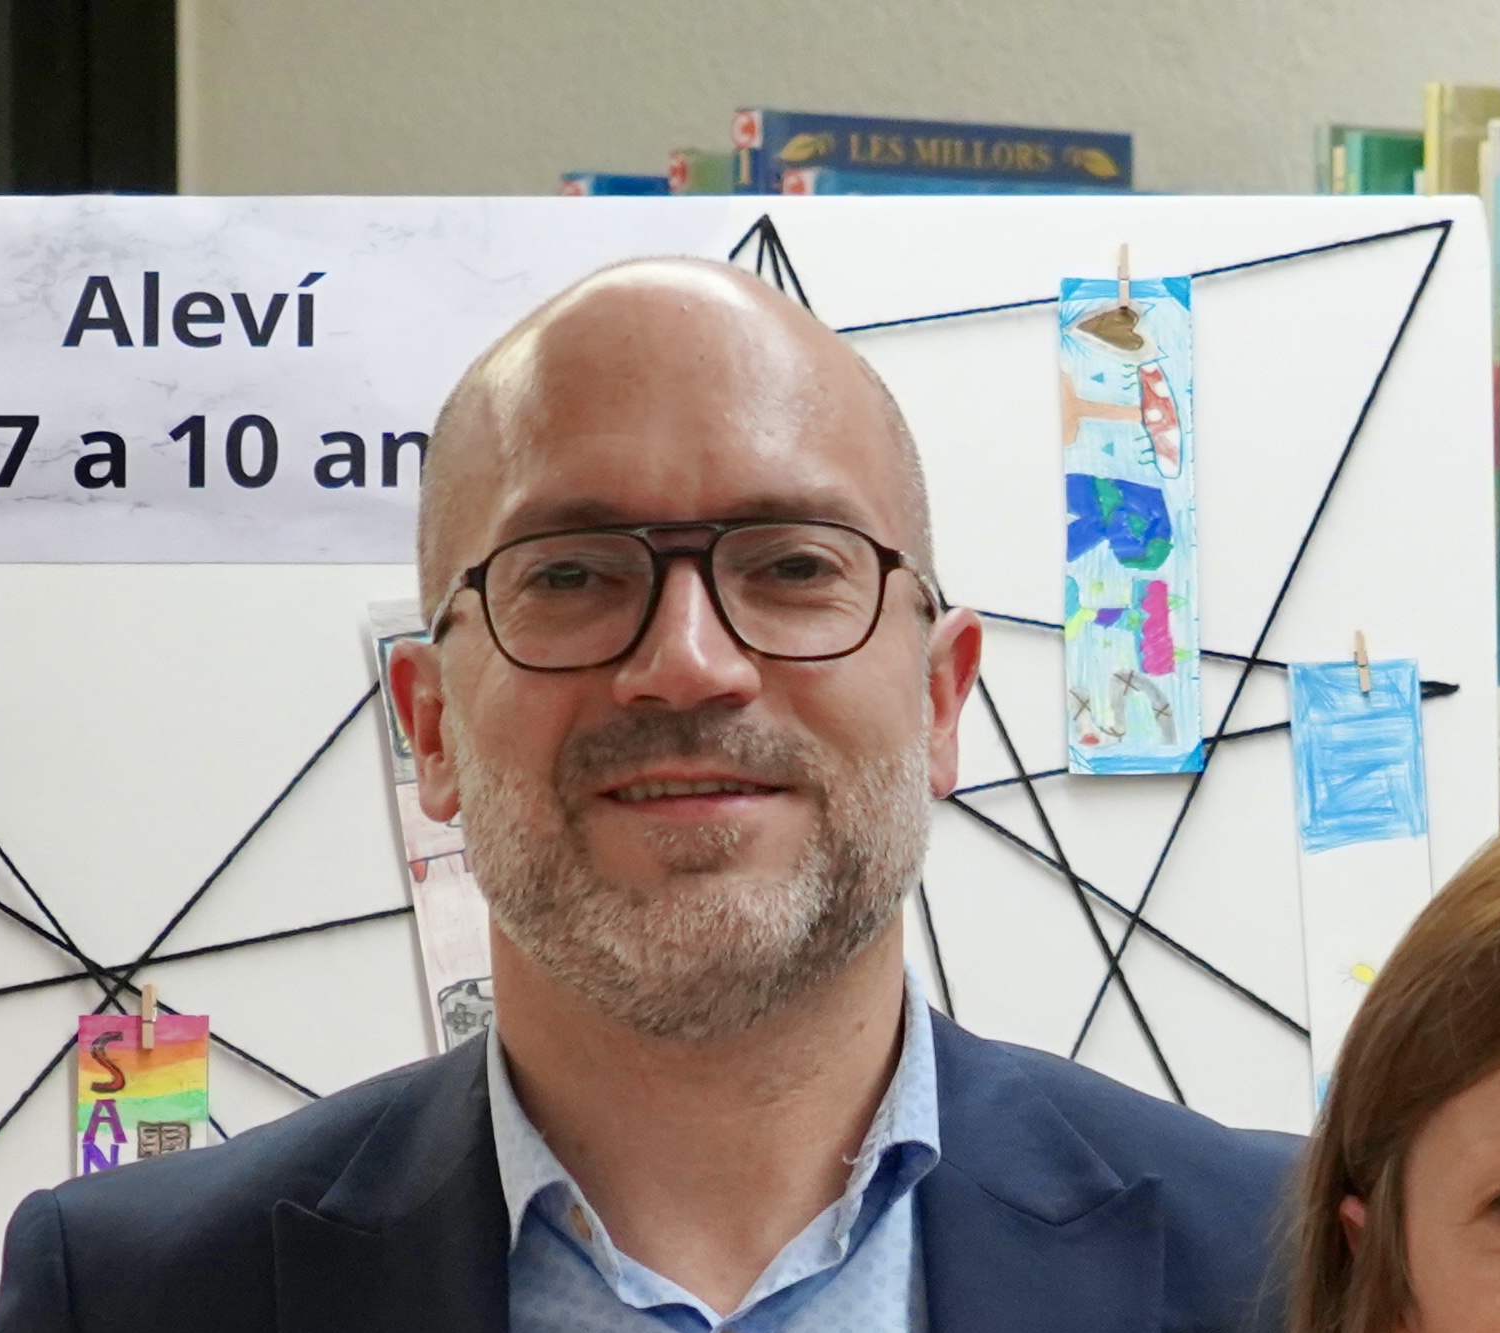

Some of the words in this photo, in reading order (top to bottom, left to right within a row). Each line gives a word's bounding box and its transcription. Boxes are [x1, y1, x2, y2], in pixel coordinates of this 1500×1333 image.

[850, 130, 907, 162] LES
[916, 134, 1054, 173] MILLORS
[62, 270, 328, 348] Aleví
[74, 431, 127, 489] a
[168, 414, 278, 489] 10
